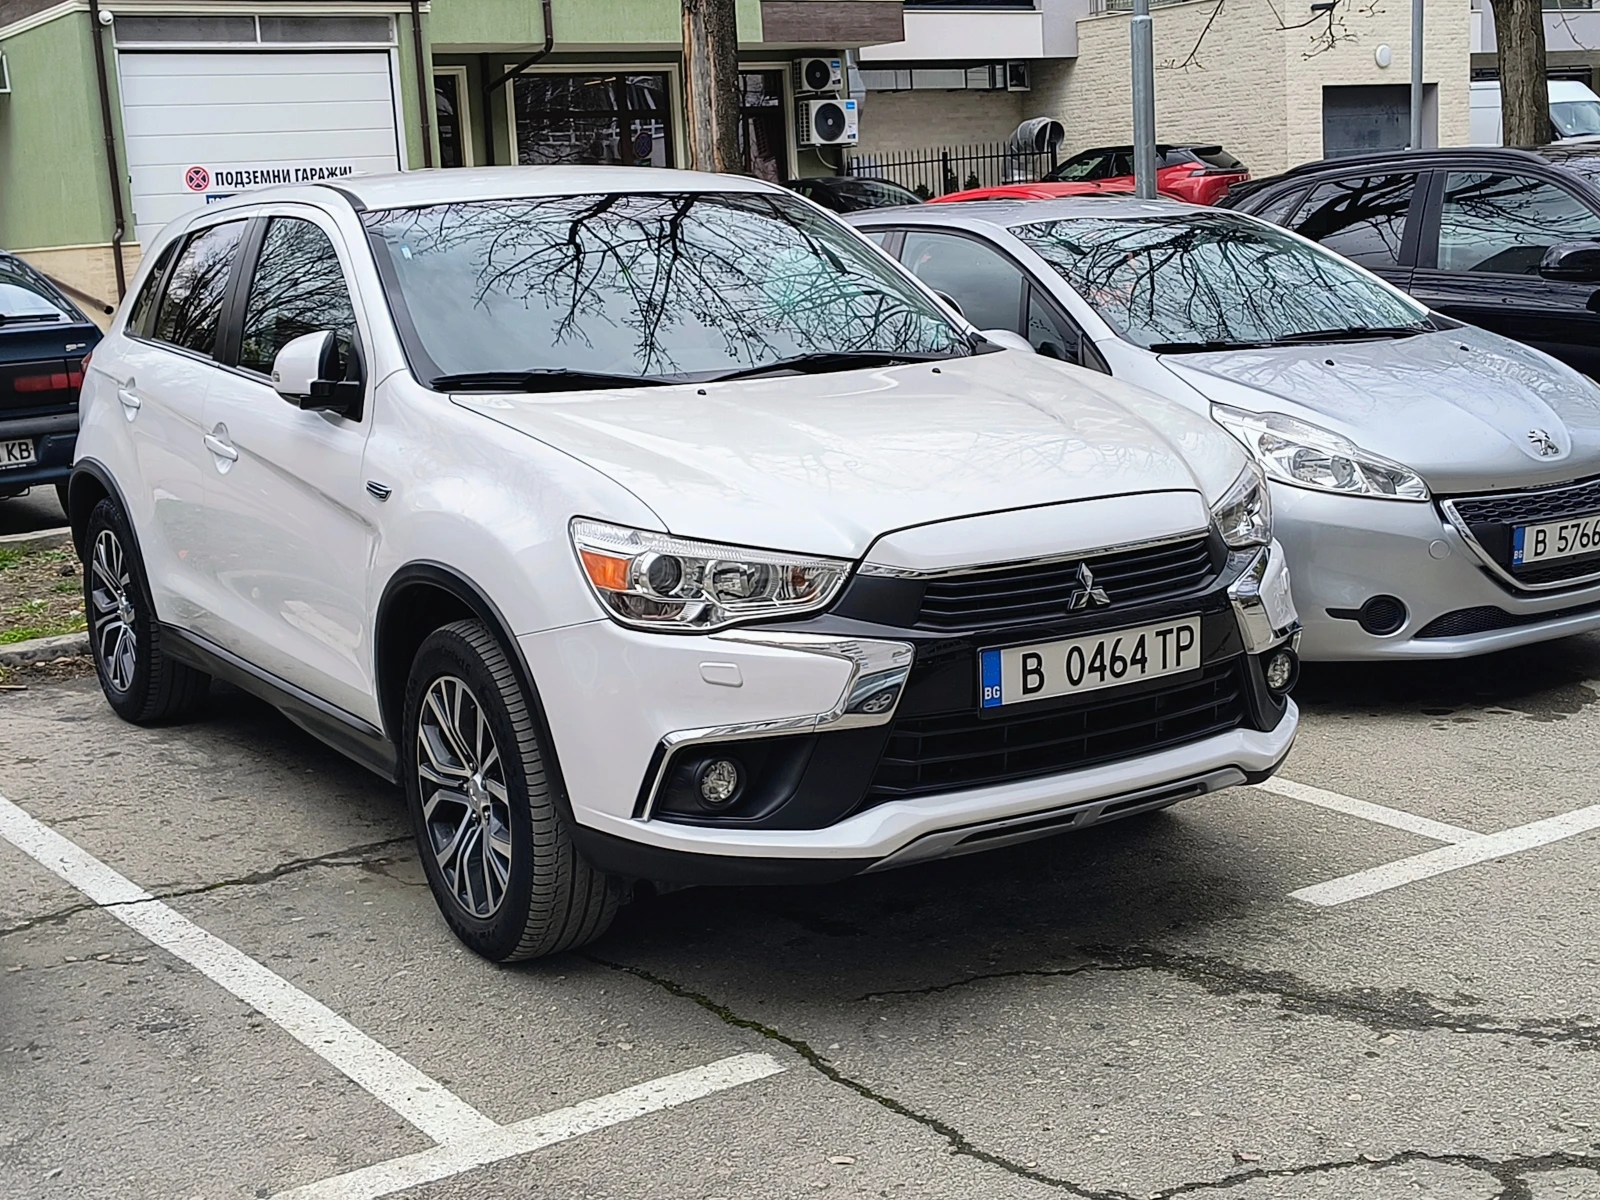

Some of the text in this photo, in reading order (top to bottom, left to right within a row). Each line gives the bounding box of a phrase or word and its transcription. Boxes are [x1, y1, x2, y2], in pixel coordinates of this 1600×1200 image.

[215, 169, 291, 188] ПОДЗЕМНИ
[6, 441, 31, 461] KB
[1534, 520, 1600, 557] B 5766
[1513, 550, 1524, 560] BG
[1022, 625, 1195, 695] B 0464 TP
[984, 685, 1000, 700] BG
